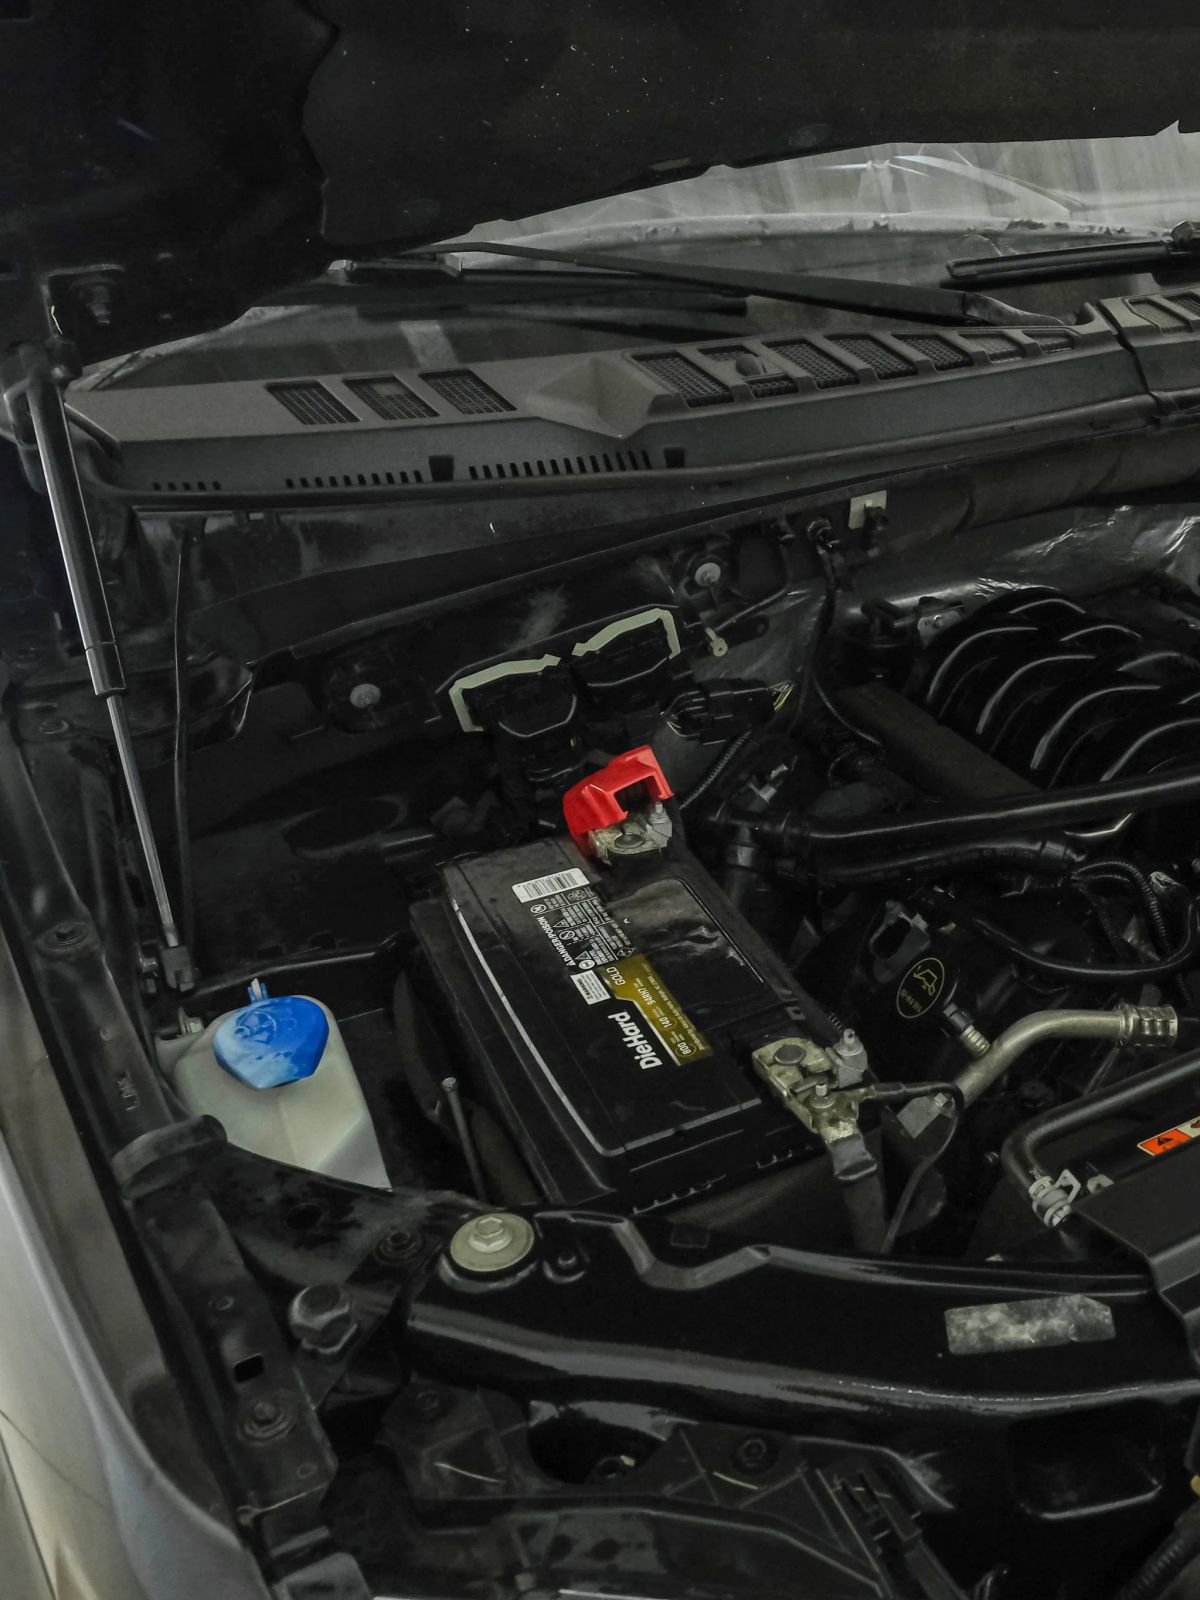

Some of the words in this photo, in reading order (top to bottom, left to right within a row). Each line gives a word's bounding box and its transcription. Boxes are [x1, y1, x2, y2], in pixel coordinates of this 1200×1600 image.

[606, 966, 626, 986] GOLD
[658, 1016, 673, 1028] 140
[607, 1011, 663, 1070] DieHard
[677, 1042, 692, 1055] 800
